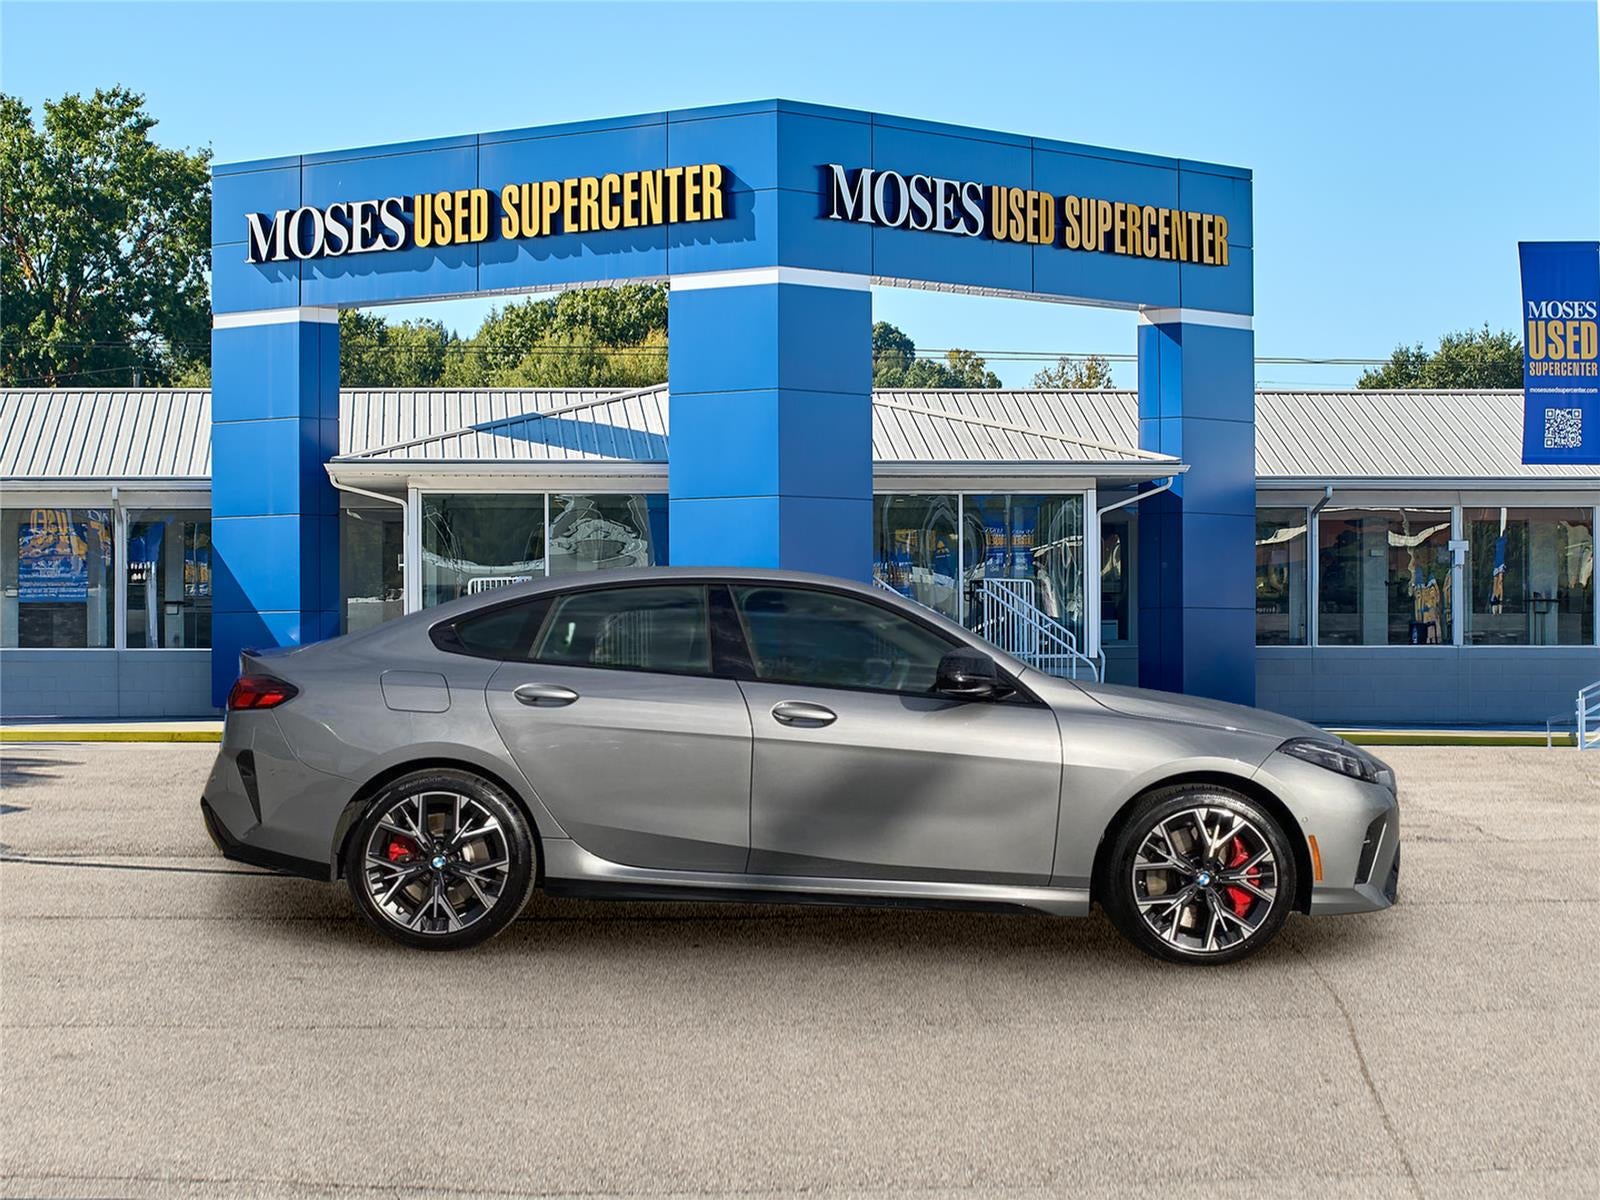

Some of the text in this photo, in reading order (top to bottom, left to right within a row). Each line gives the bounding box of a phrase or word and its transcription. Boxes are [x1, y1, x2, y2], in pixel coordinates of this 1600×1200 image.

[245, 163, 723, 264] MOSES USED SUPERCENTER
[829, 164, 1229, 266] MOSES USED SUPERCENTER
[1528, 301, 1597, 319] MOSES
[1528, 320, 1598, 360] USED
[1529, 361, 1598, 377] SUPERCENTER
